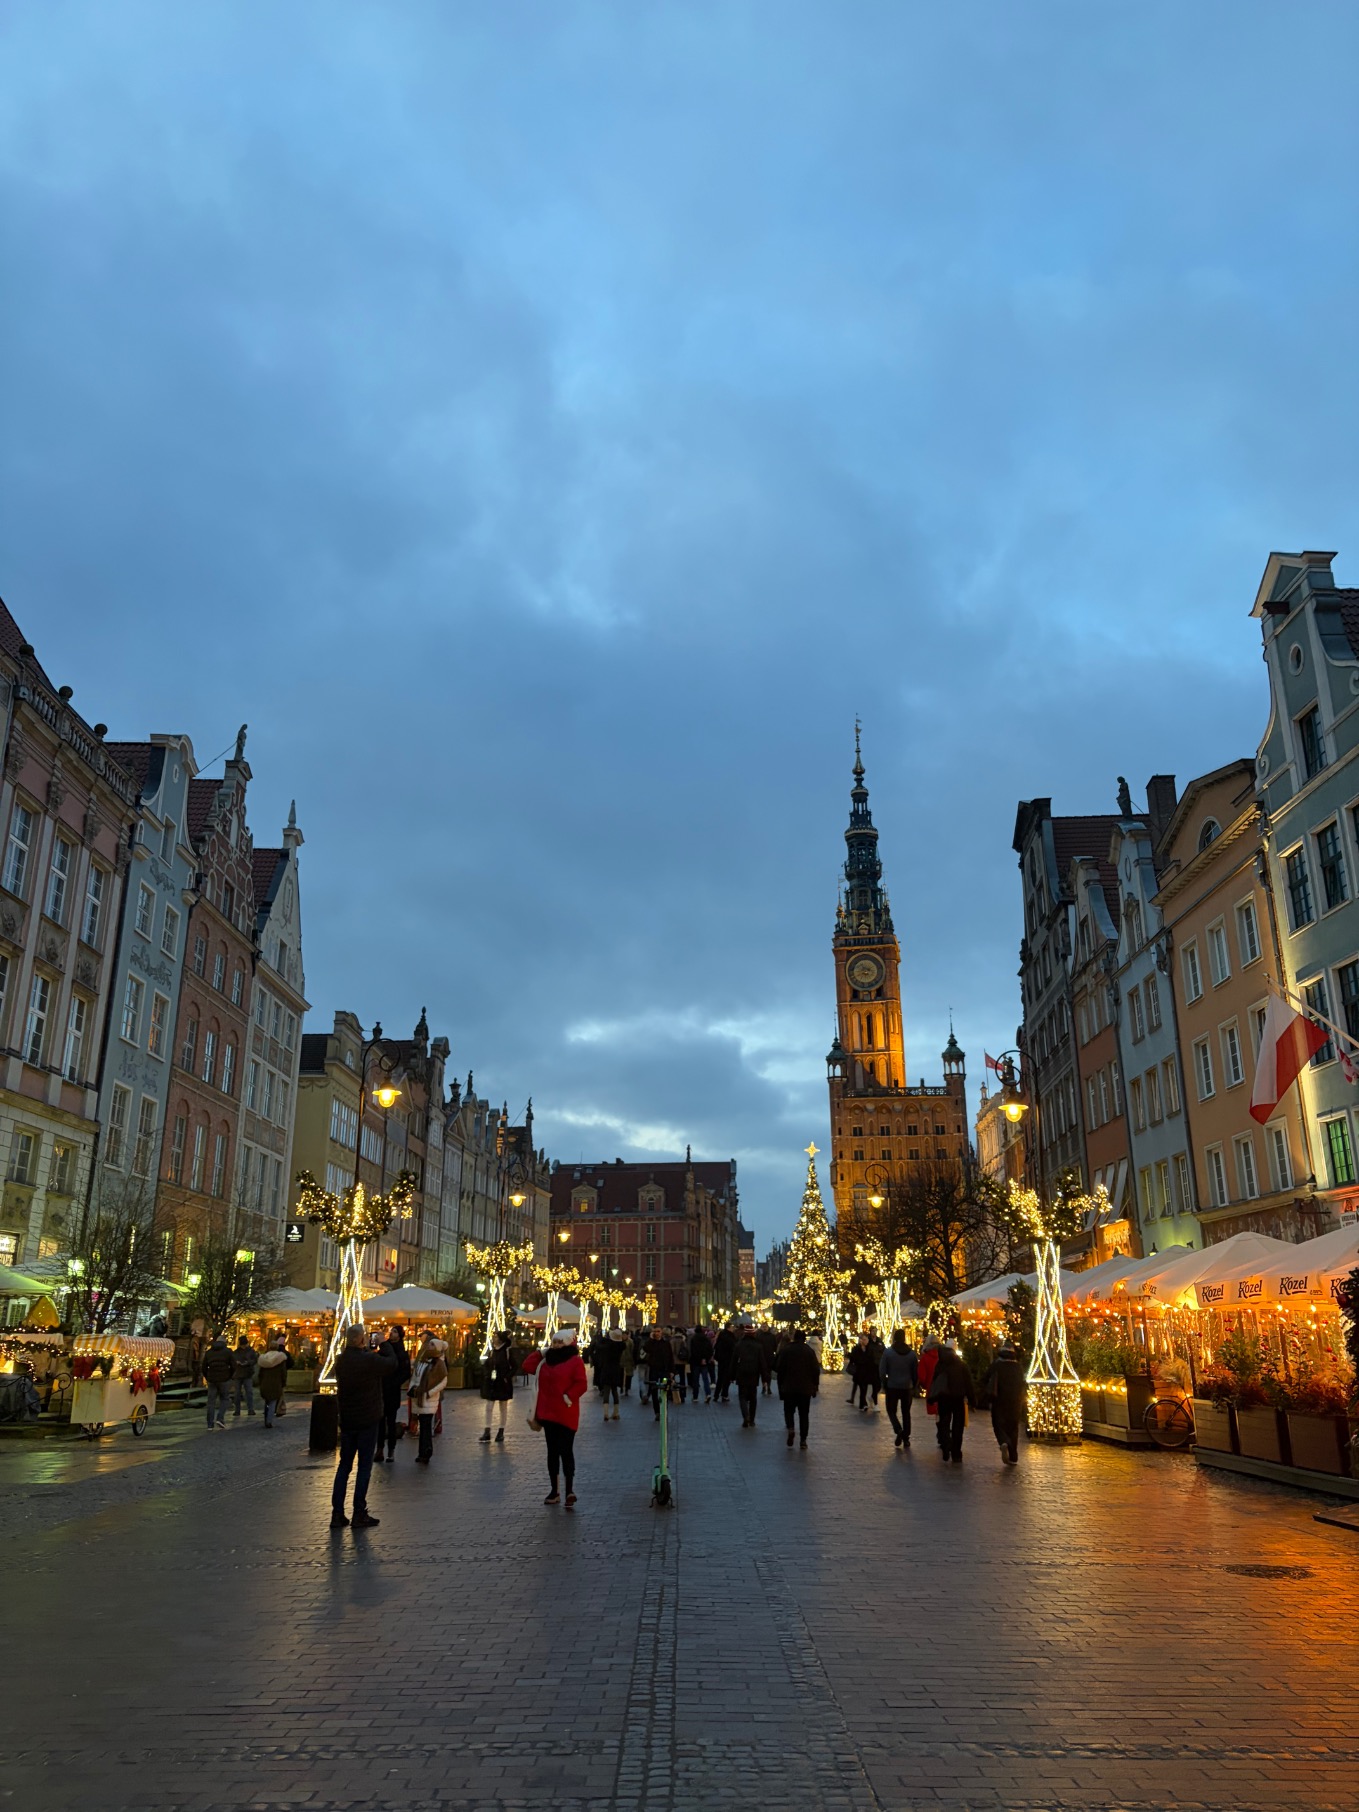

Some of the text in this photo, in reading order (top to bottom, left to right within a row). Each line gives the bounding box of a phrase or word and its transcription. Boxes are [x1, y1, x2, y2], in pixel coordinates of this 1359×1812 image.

[1202, 1284, 1224, 1302] Kozel
[1238, 1280, 1262, 1299] Kozel
[1279, 1276, 1308, 1295] Kozel
